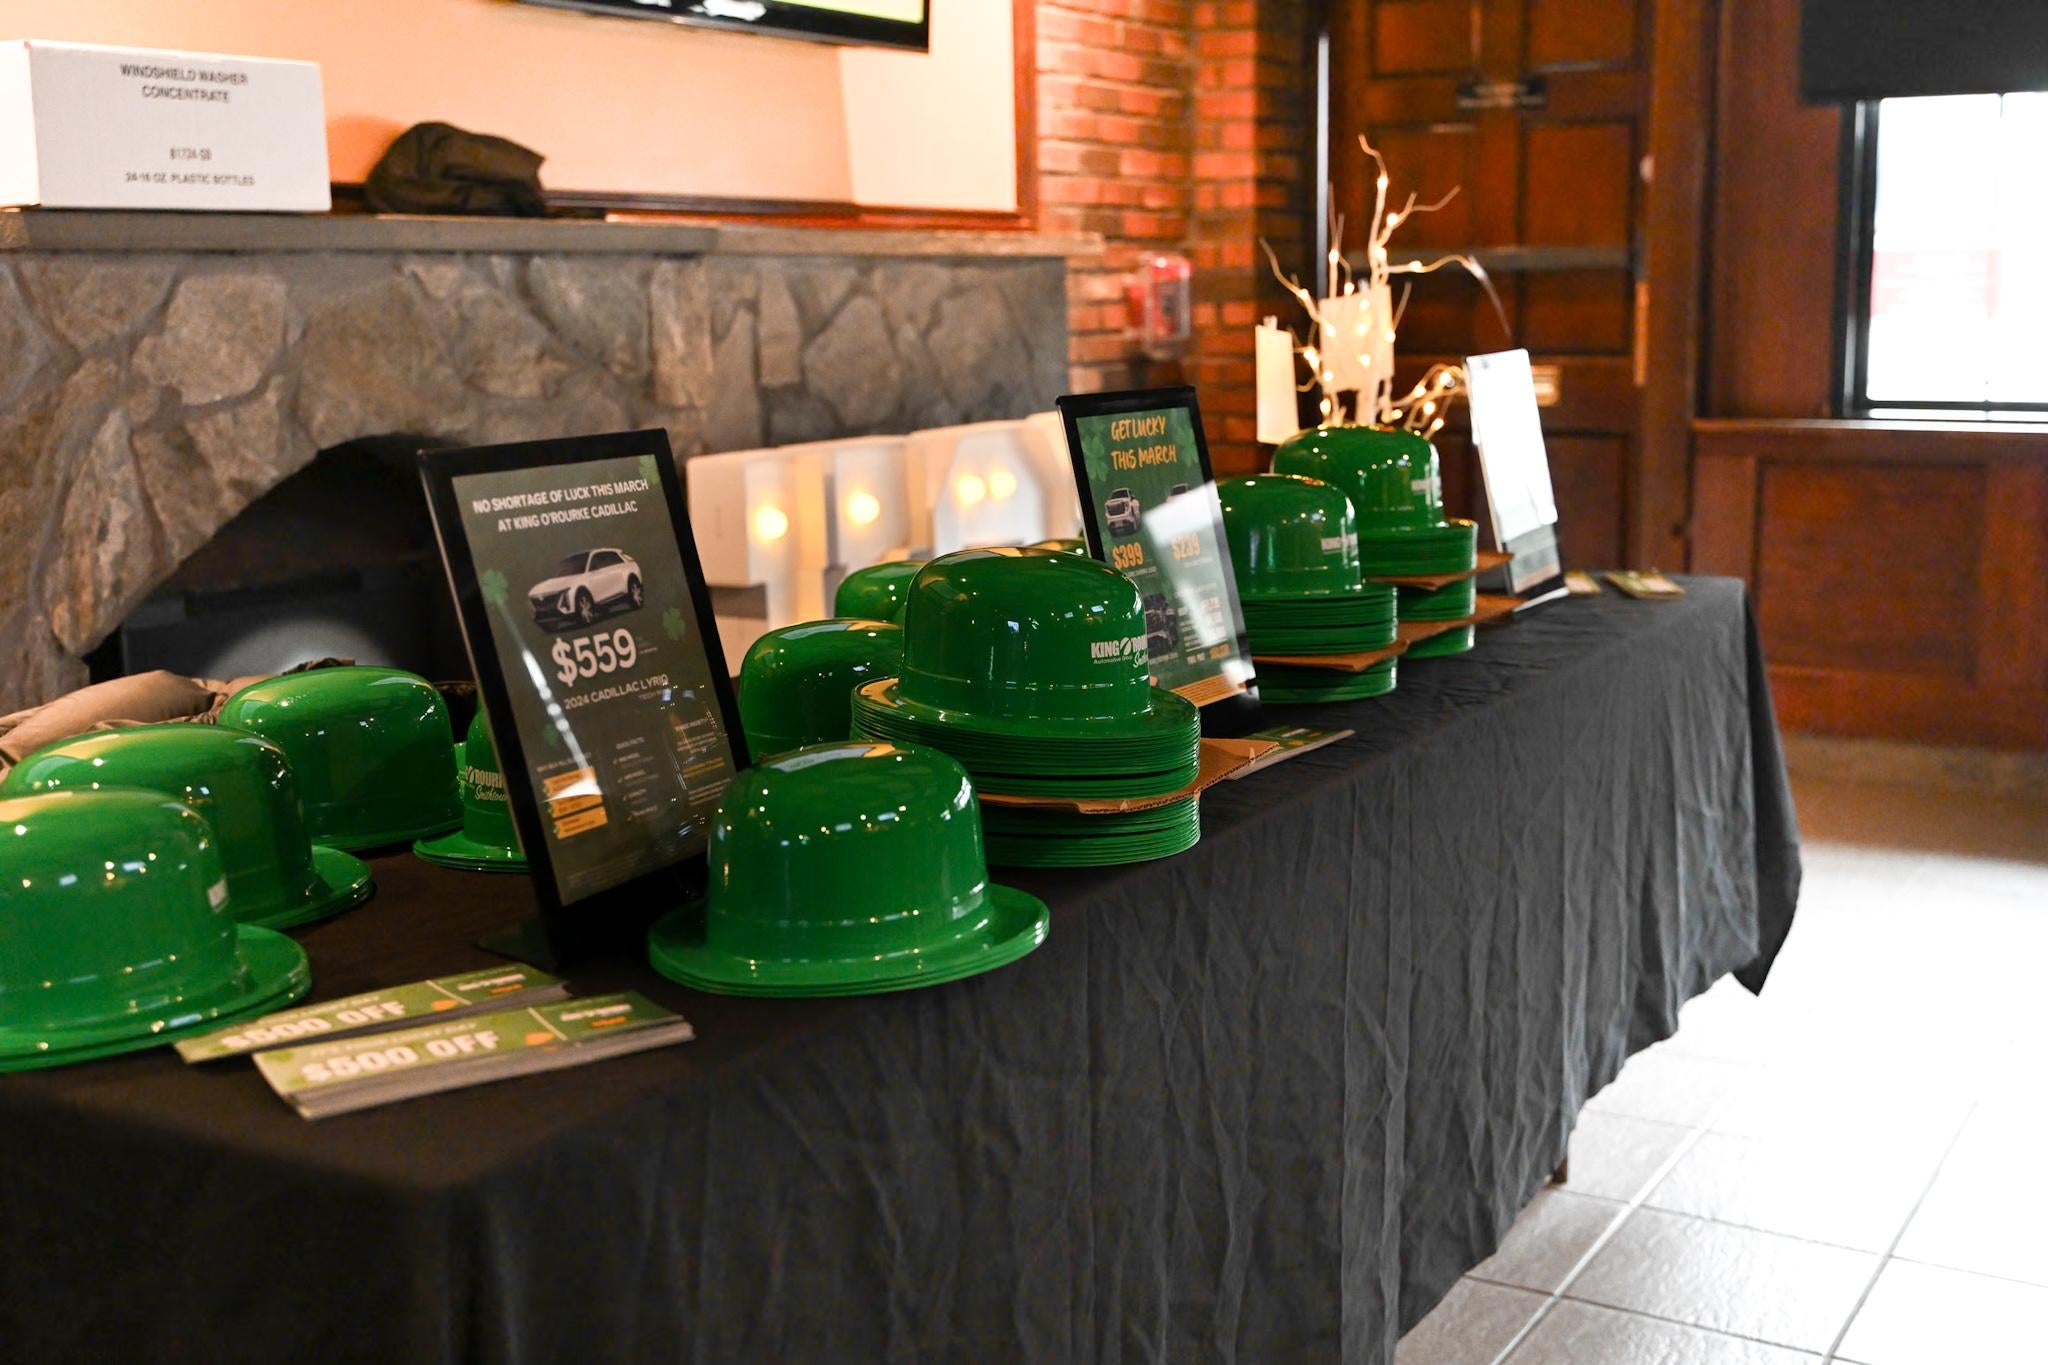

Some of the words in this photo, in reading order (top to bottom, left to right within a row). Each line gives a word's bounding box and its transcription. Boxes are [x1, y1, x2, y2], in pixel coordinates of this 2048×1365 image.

[120, 64, 196, 82] WINDSHIELD
[199, 70, 248, 86] WASHER
[142, 85, 230, 103] CONCENTRATE
[170, 173, 208, 185] PLASTIC
[213, 174, 255, 186] BOTTLES
[1111, 418, 1132, 441] GET
[1132, 415, 1166, 438] LUCKY
[1111, 450, 1137, 470] THIS
[1138, 444, 1177, 468] MARCH
[472, 499, 491, 514] NO
[492, 491, 549, 511] SHORTAGE
[549, 489, 564, 504] OF
[564, 485, 591, 501] LUCK
[590, 483, 613, 497] THIS
[613, 479, 648, 495] MARCH
[498, 517, 512, 532] AT
[513, 514, 540, 530] KING
[541, 508, 591, 526] O'ROURKE
[591, 500, 638, 518] CADILLAC
[1112, 542, 1144, 570] $399
[552, 627, 637, 688] $559
[1091, 639, 1120, 659] KING
[563, 693, 590, 710] 2024
[590, 681, 640, 703] CADILLAC
[640, 673, 669, 690] LYRIQ
[336, 1000, 406, 1025] OFF
[301, 1046, 419, 1083] $500
[425, 1029, 500, 1058] OFF
